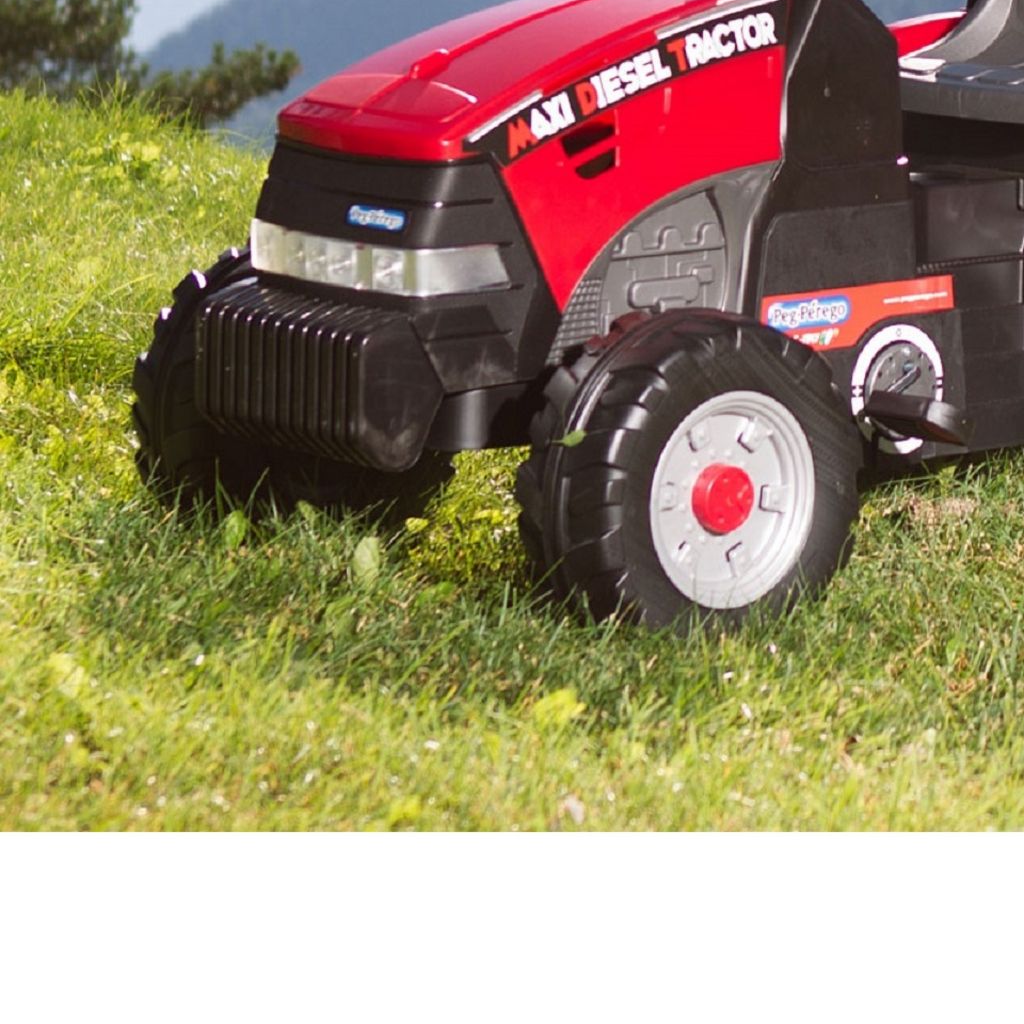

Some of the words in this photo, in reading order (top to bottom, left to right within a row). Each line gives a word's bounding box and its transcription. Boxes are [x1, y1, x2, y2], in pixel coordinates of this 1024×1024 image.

[509, 92, 576, 157] MAXI
[576, 49, 672, 115] DIESEL
[667, 13, 777, 71] TRACTOR
